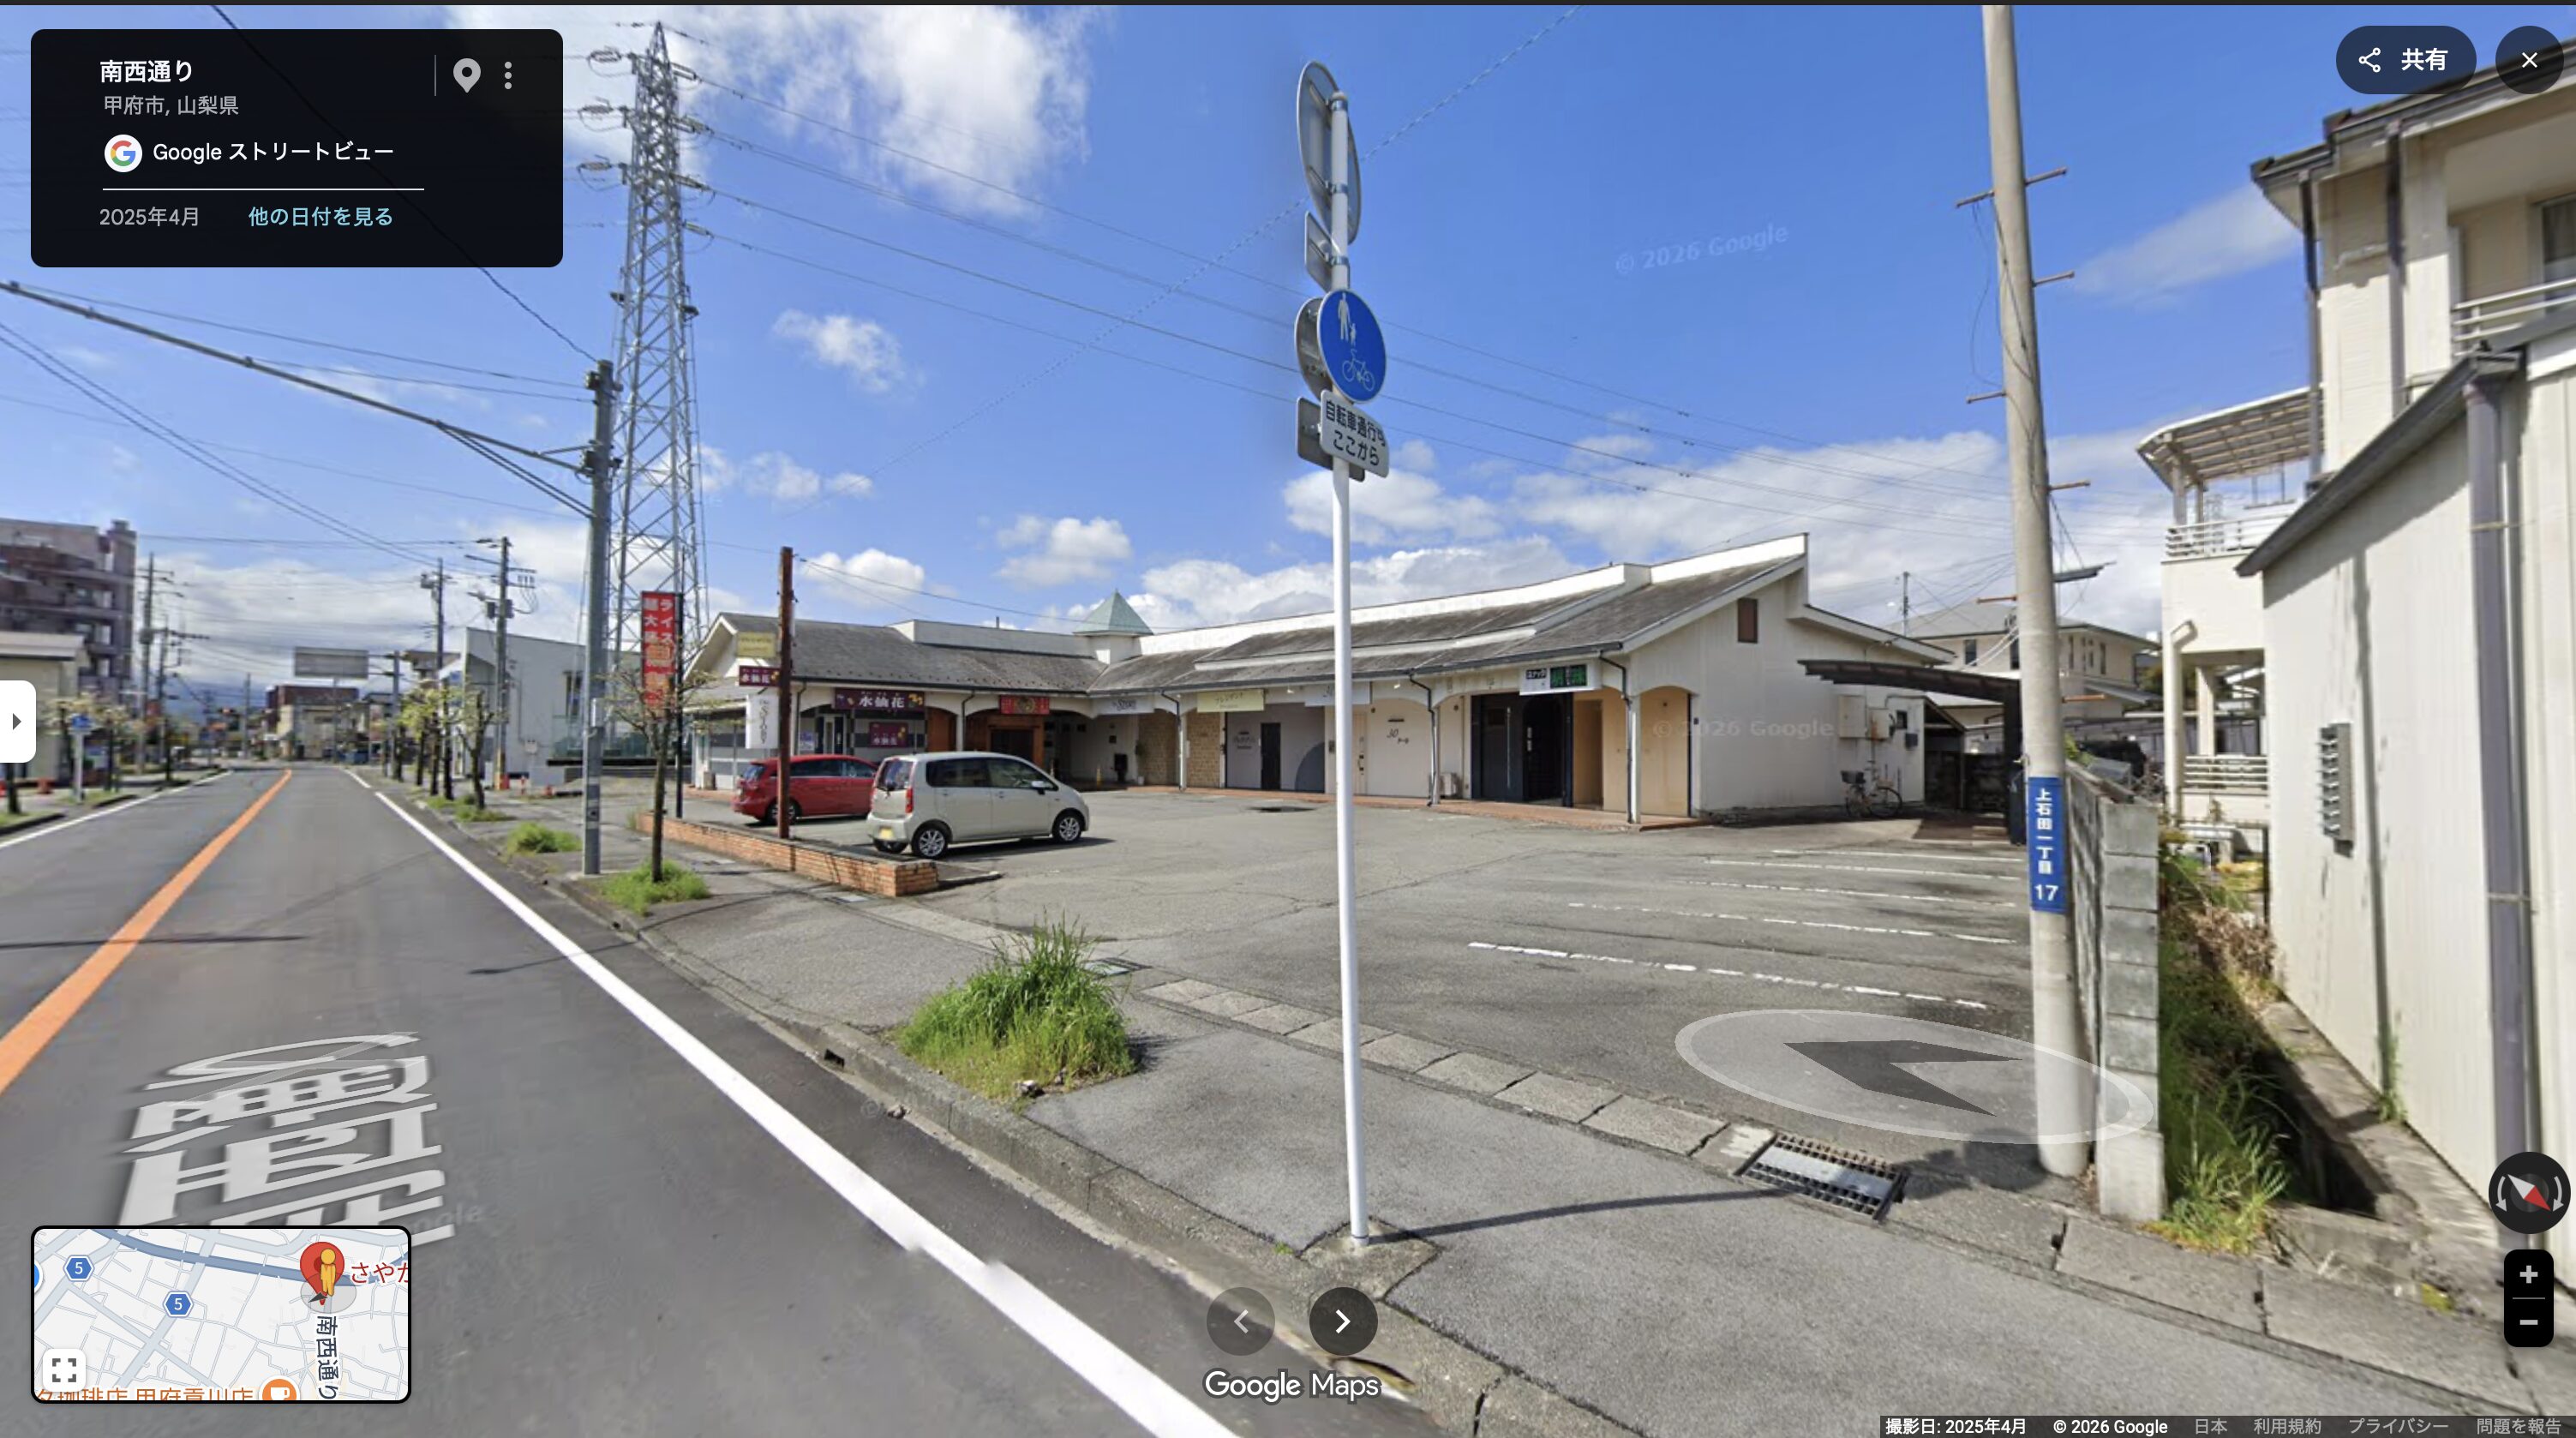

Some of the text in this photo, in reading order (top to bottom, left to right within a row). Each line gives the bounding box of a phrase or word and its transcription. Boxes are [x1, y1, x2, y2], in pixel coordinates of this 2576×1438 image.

[1333, 429, 1380, 466] ここから
[859, 696, 905, 709] 水仙花
[2035, 788, 2053, 875] 上石田一丁目
[2034, 884, 2058, 902] 17
